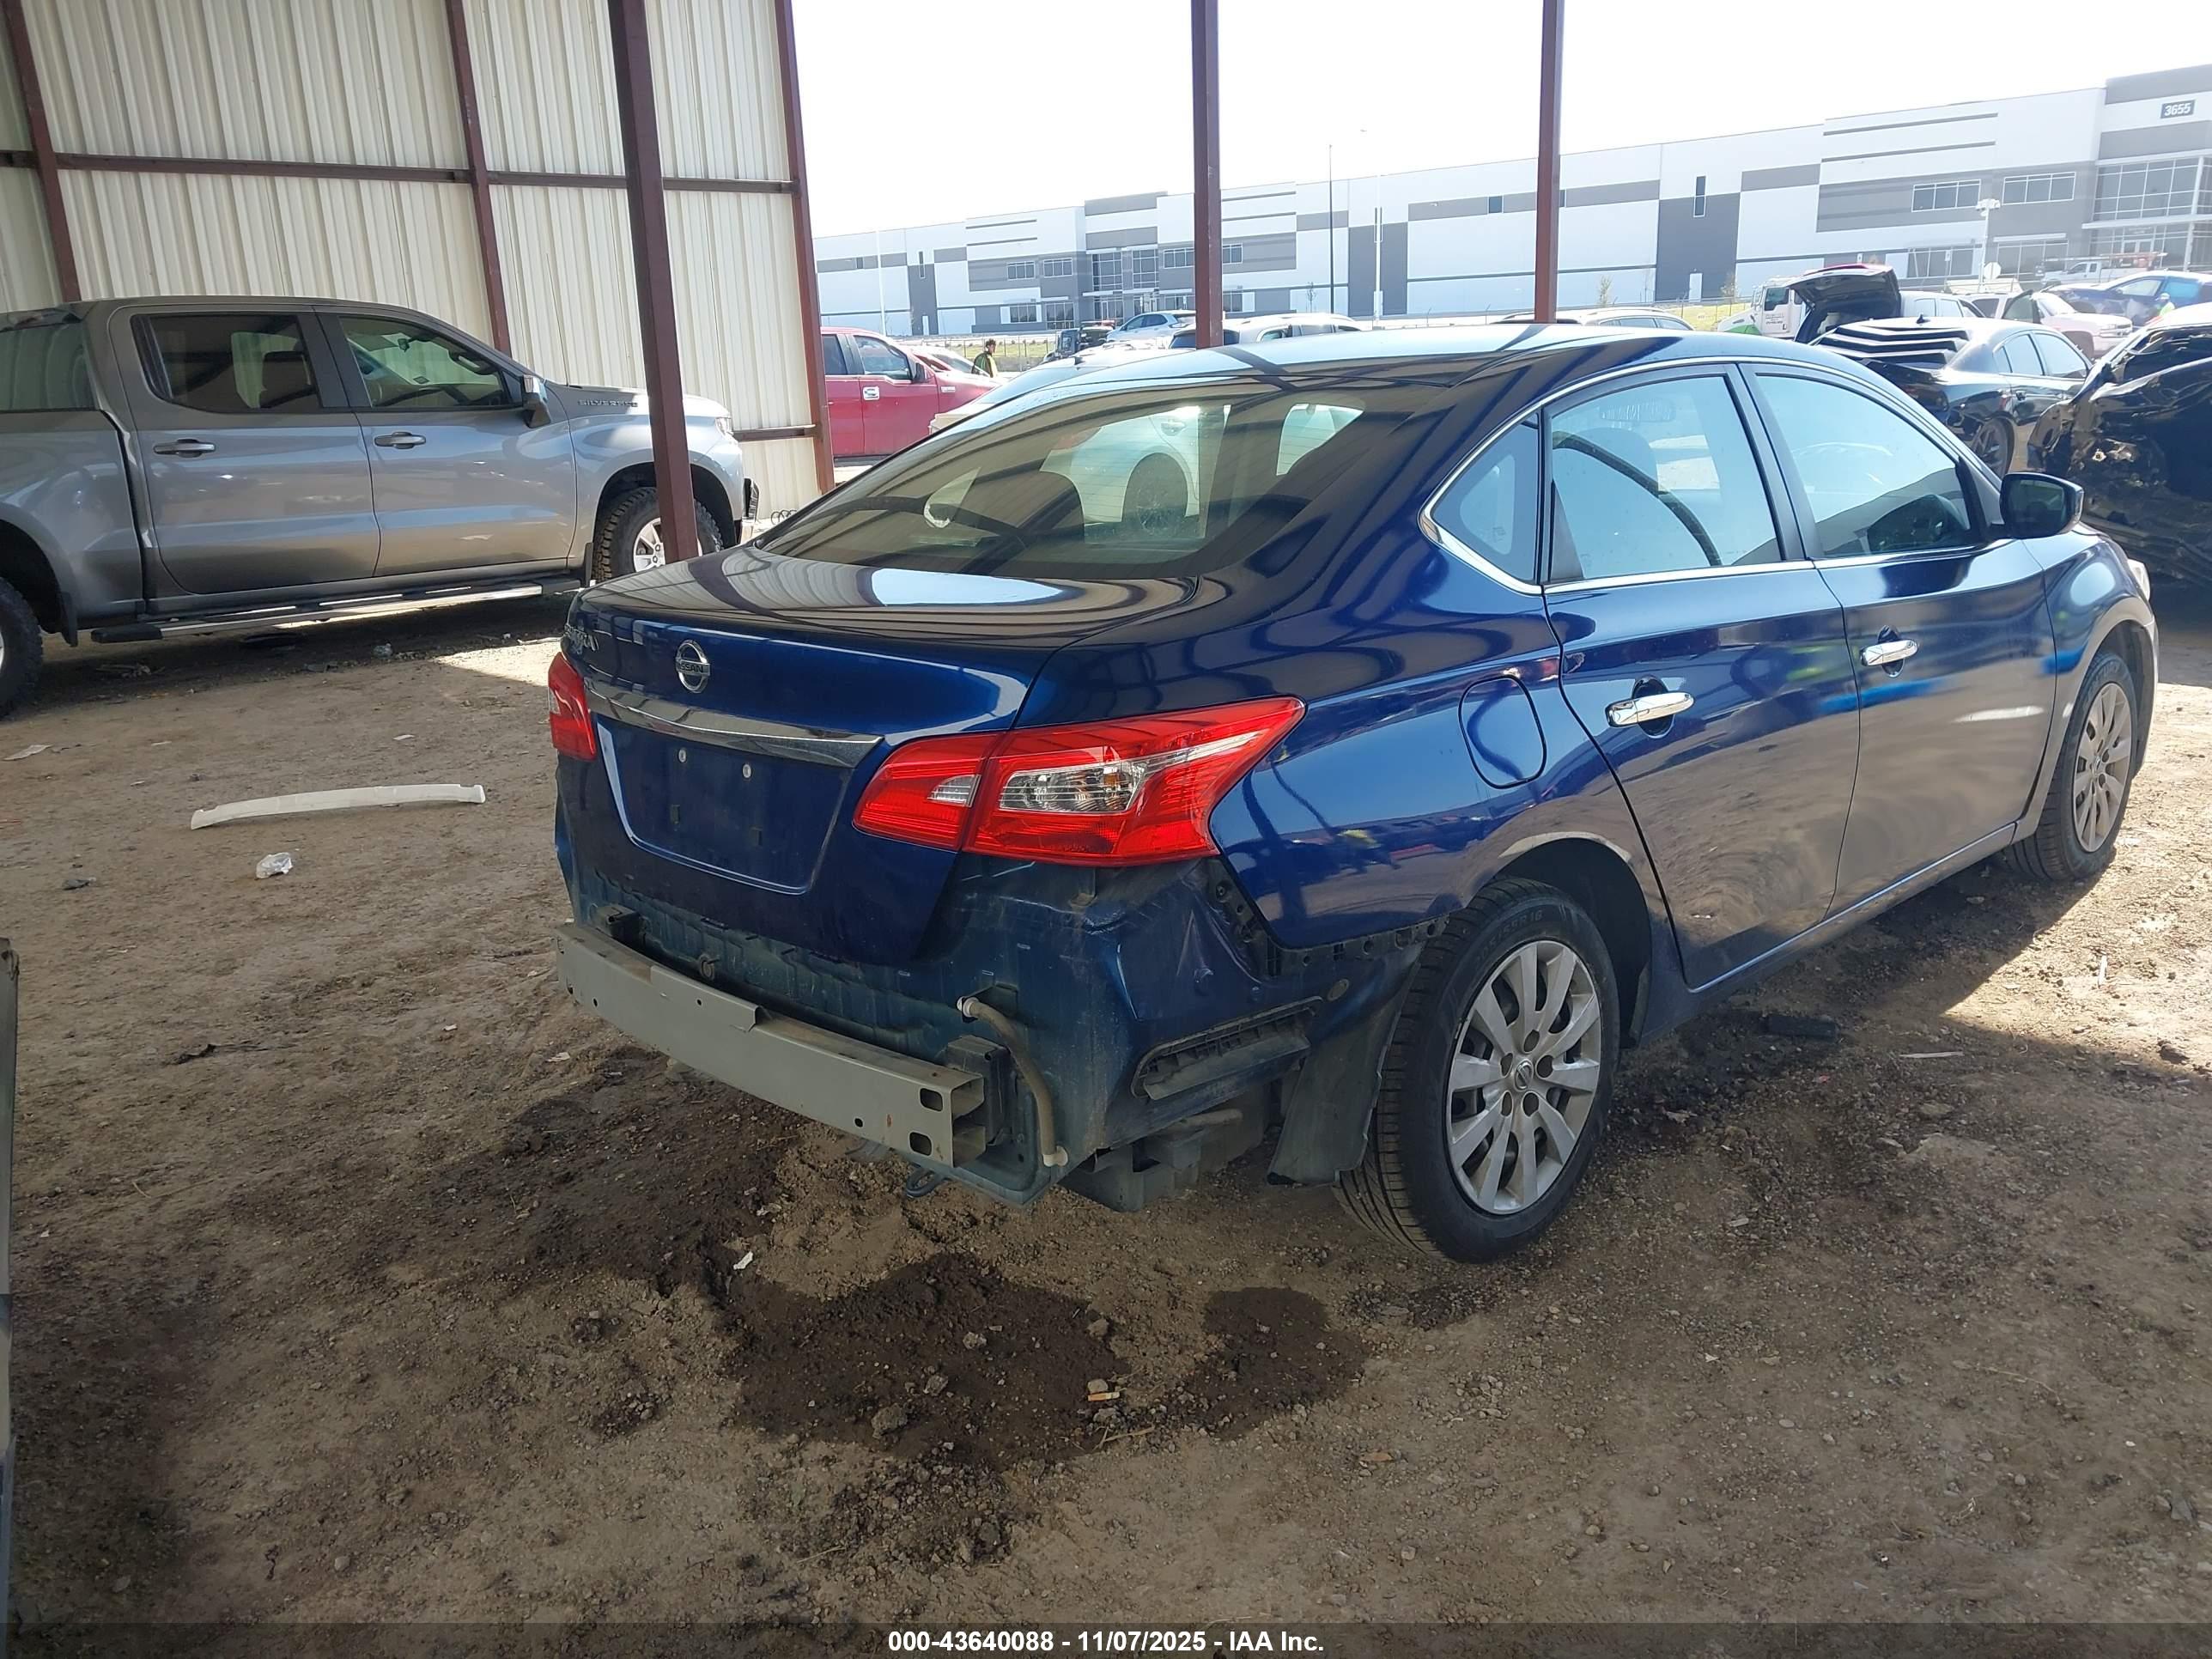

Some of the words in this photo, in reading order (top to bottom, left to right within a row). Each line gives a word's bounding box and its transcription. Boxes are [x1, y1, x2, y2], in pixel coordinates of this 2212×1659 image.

[2164, 102, 2191, 117] 3655
[677, 659, 704, 673] SSAN
[1476, 909, 1543, 963] 05/5R16
